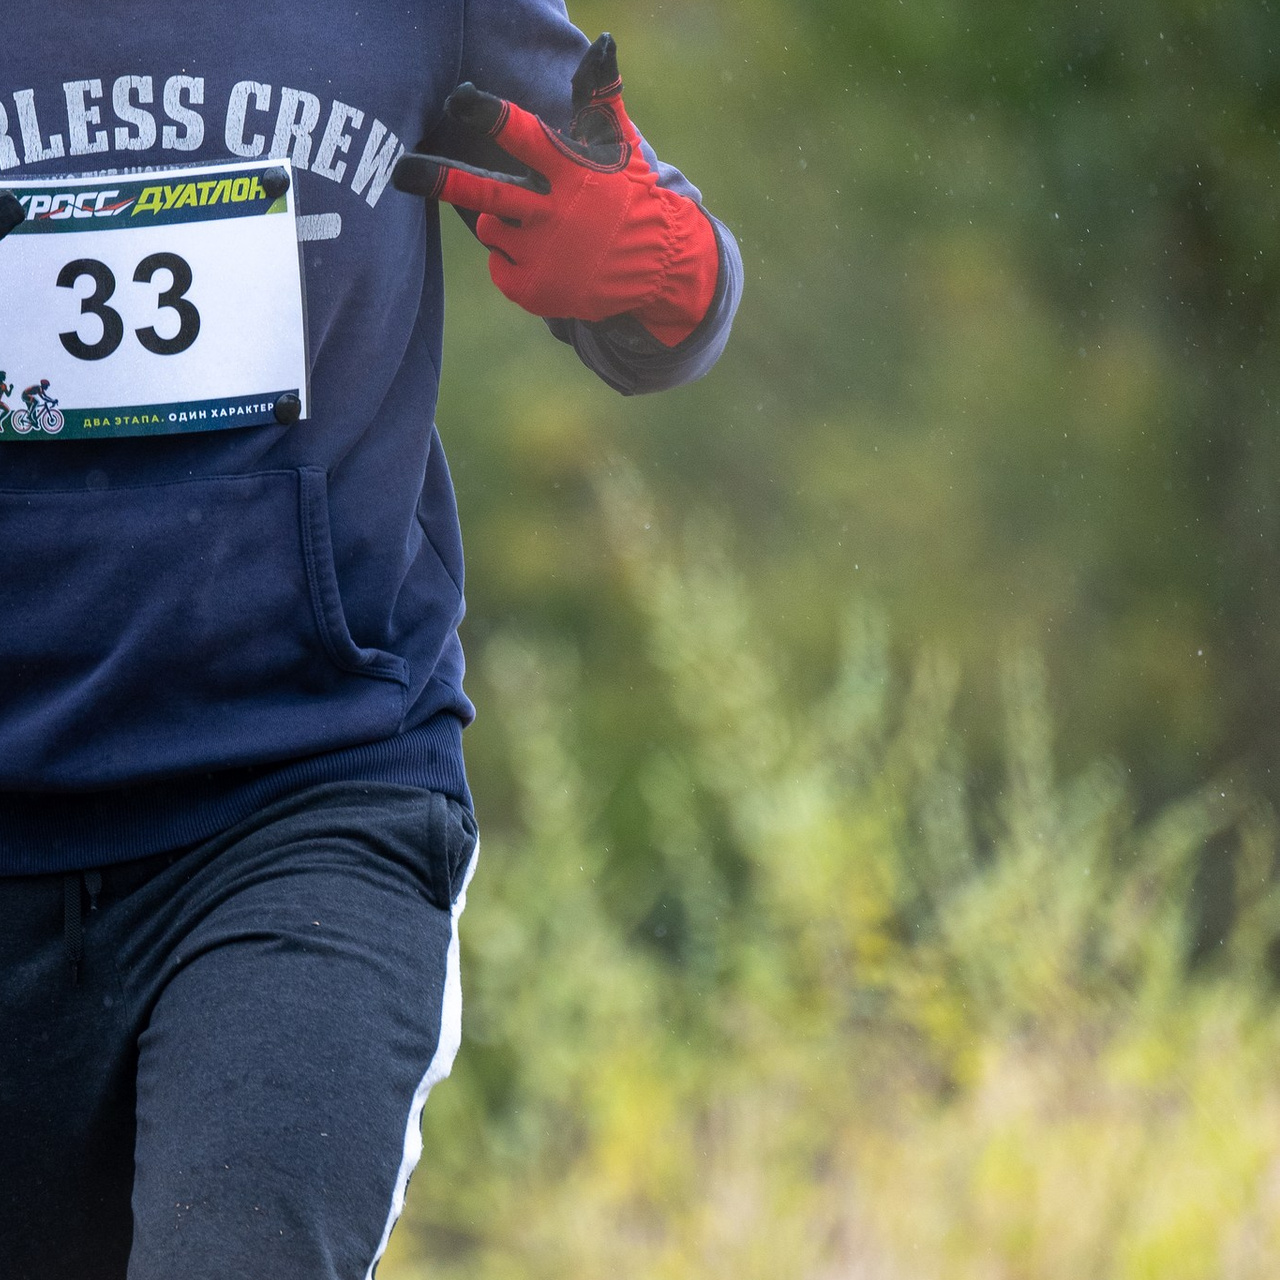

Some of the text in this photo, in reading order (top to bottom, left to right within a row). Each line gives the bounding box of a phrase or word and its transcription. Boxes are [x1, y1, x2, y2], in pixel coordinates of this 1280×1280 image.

[224, 80, 406, 209] CREW
[15, 189, 120, 221] РОСС
[55, 251, 202, 362] 33
[83, 417, 111, 429] ДВА
[168, 409, 208, 423] ОДИН
[210, 401, 275, 419] ХАРАКТЕР
